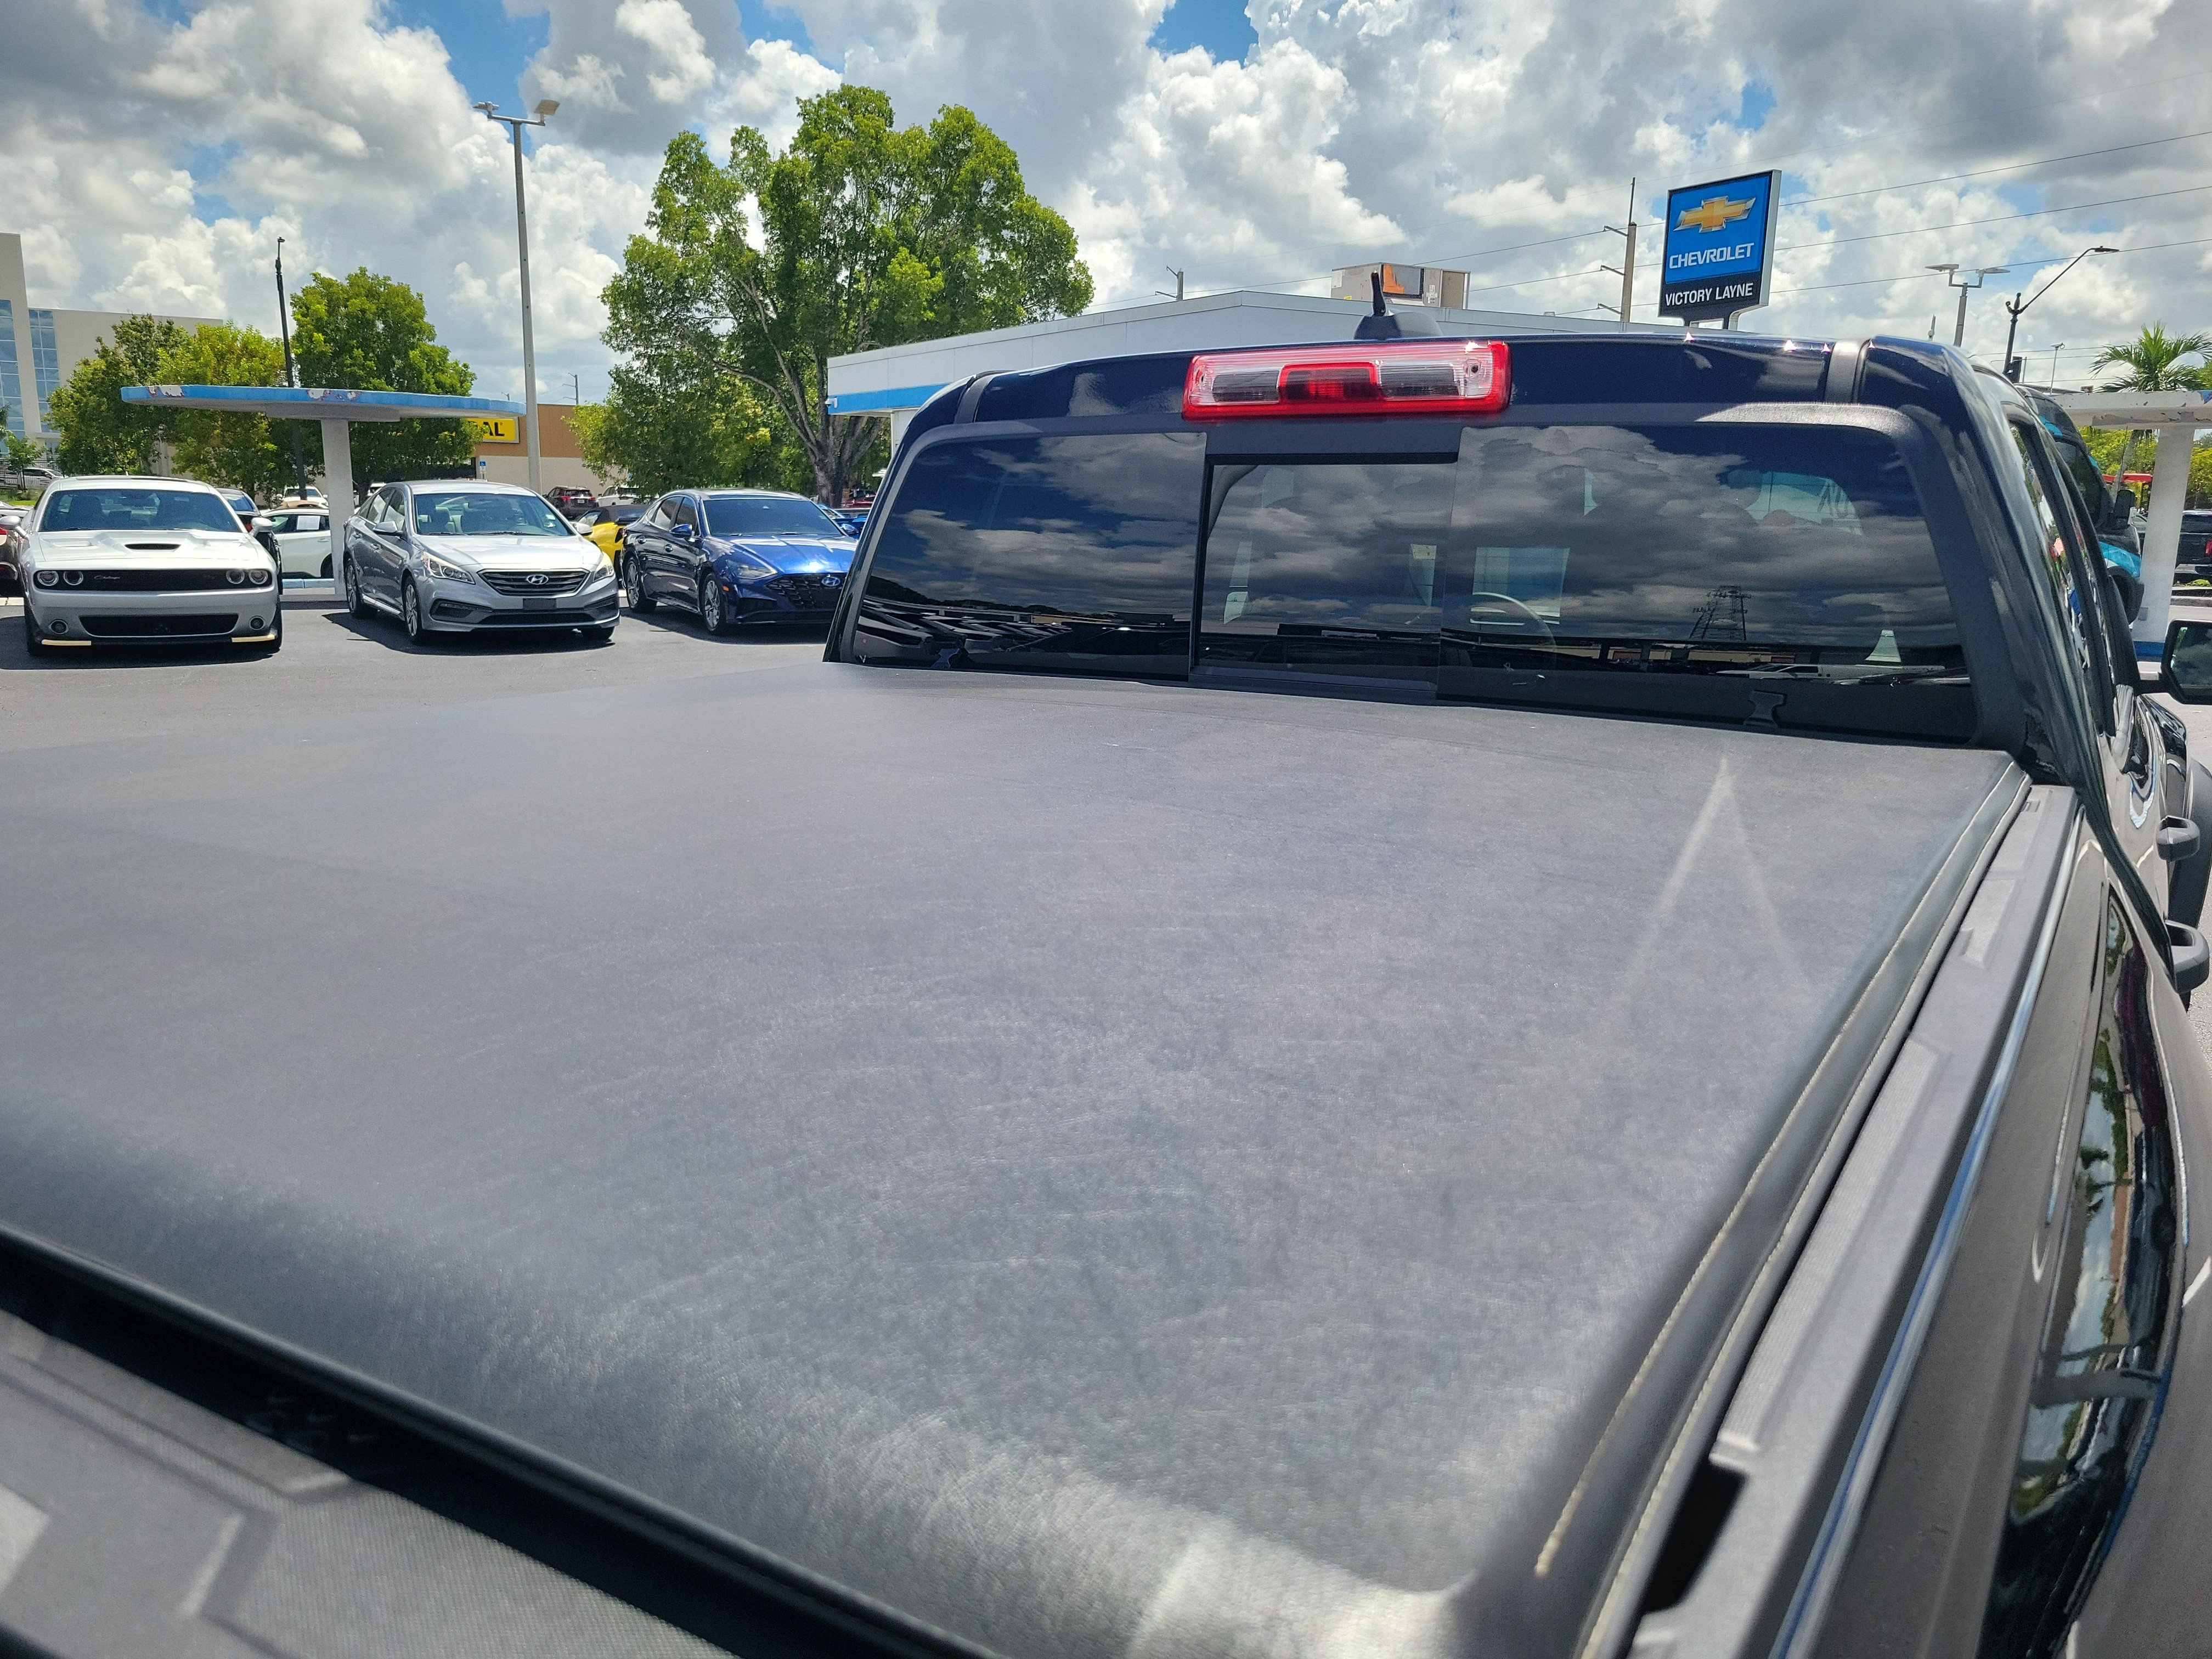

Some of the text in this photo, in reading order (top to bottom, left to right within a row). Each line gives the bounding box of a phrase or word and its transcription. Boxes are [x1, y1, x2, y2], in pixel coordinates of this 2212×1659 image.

[1669, 242, 1754, 269] CHEVROLET
[1665, 283, 1754, 306] VICTORY LAYNE
